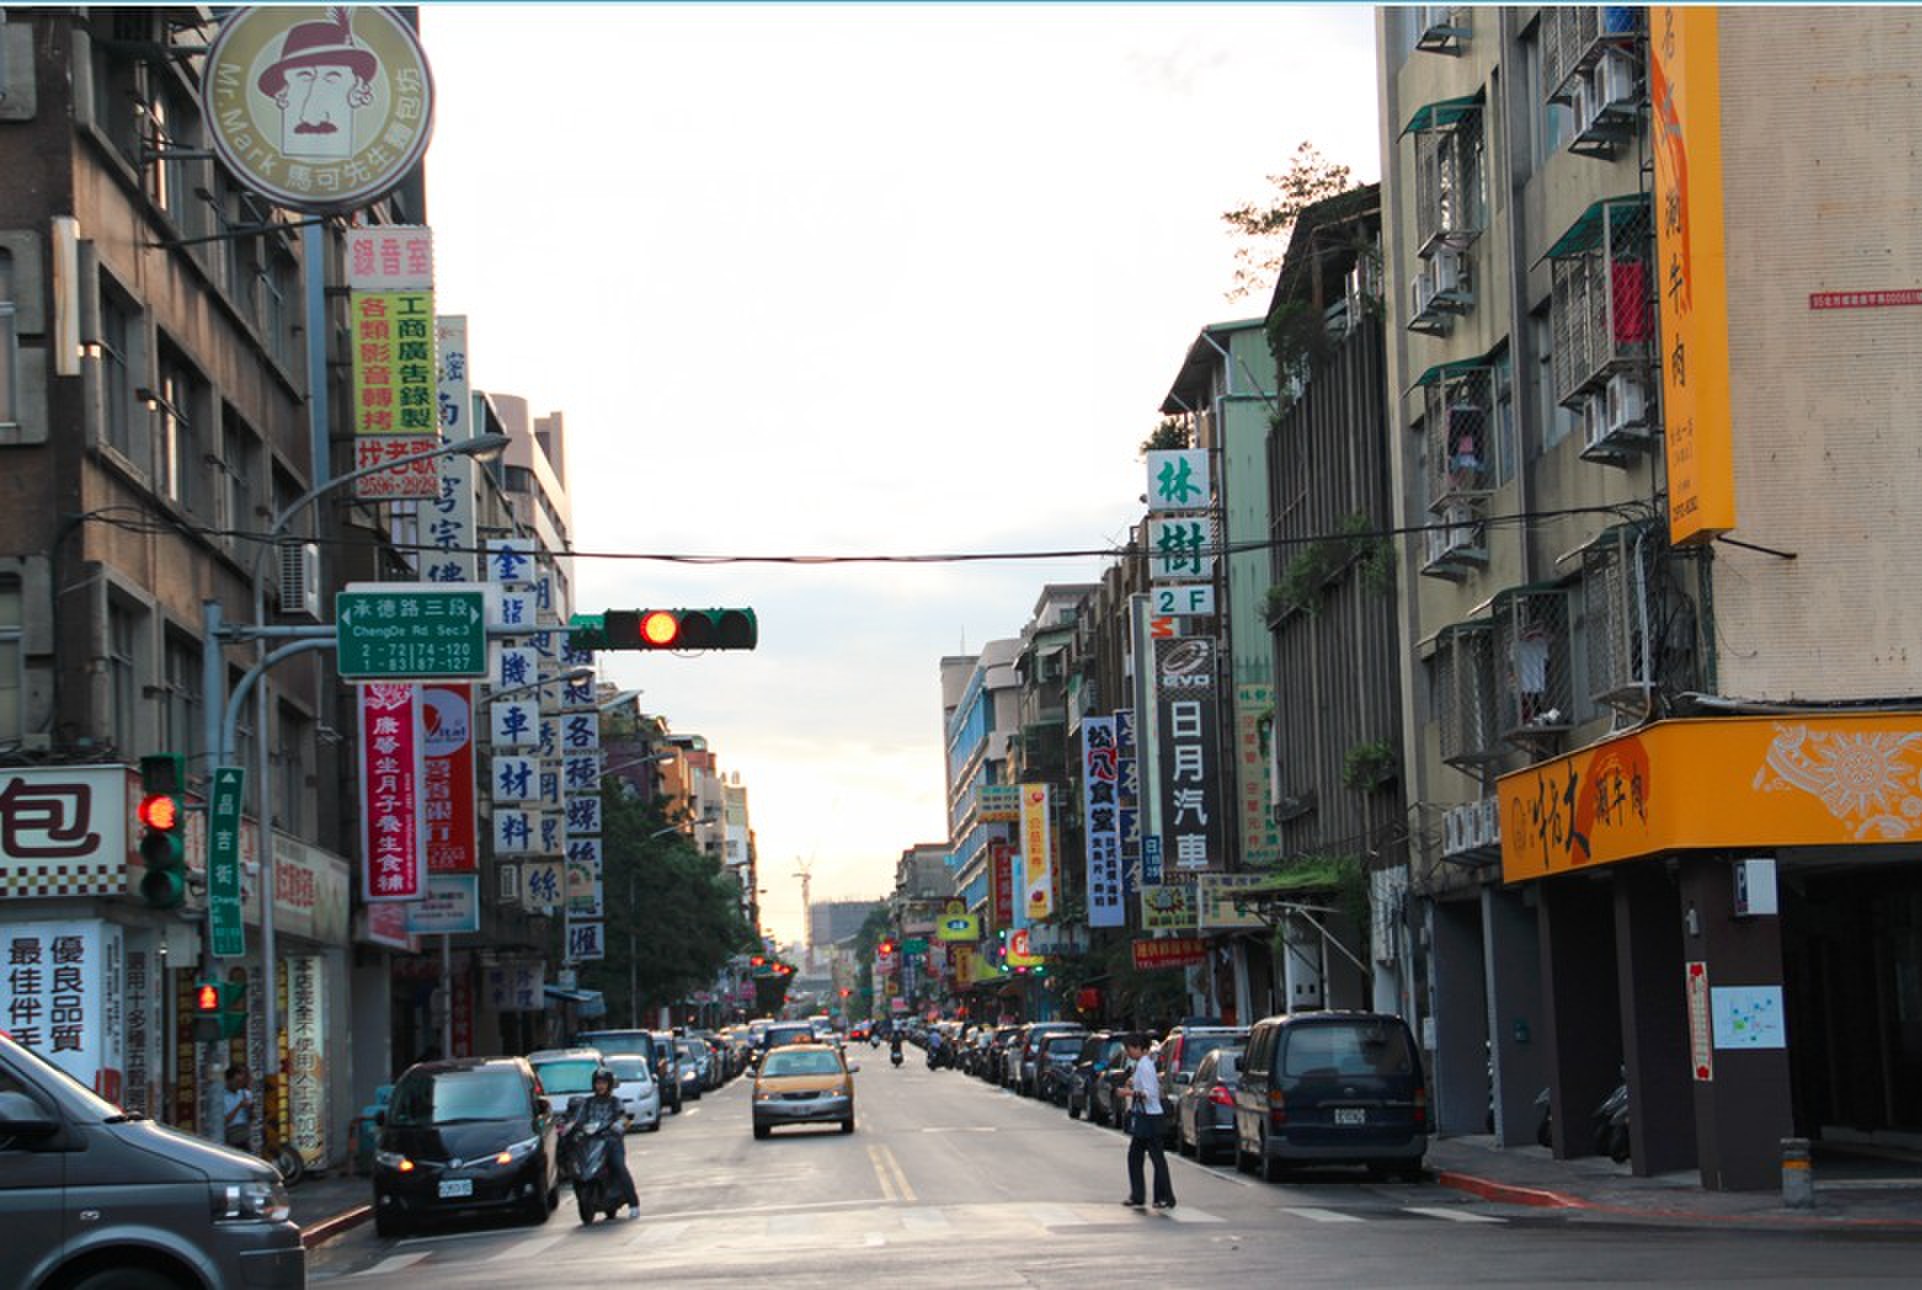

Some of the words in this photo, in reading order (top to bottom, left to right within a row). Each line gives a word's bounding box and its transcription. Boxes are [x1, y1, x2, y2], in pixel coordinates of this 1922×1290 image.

[353, 599, 468, 618] 承德路三段
[1159, 590, 1205, 612] 2F
[412, 625, 429, 636] Rd
[1171, 701, 1208, 869] 日月汽車
[0, 777, 100, 858] 包
[50, 935, 84, 1053] 優良品質
